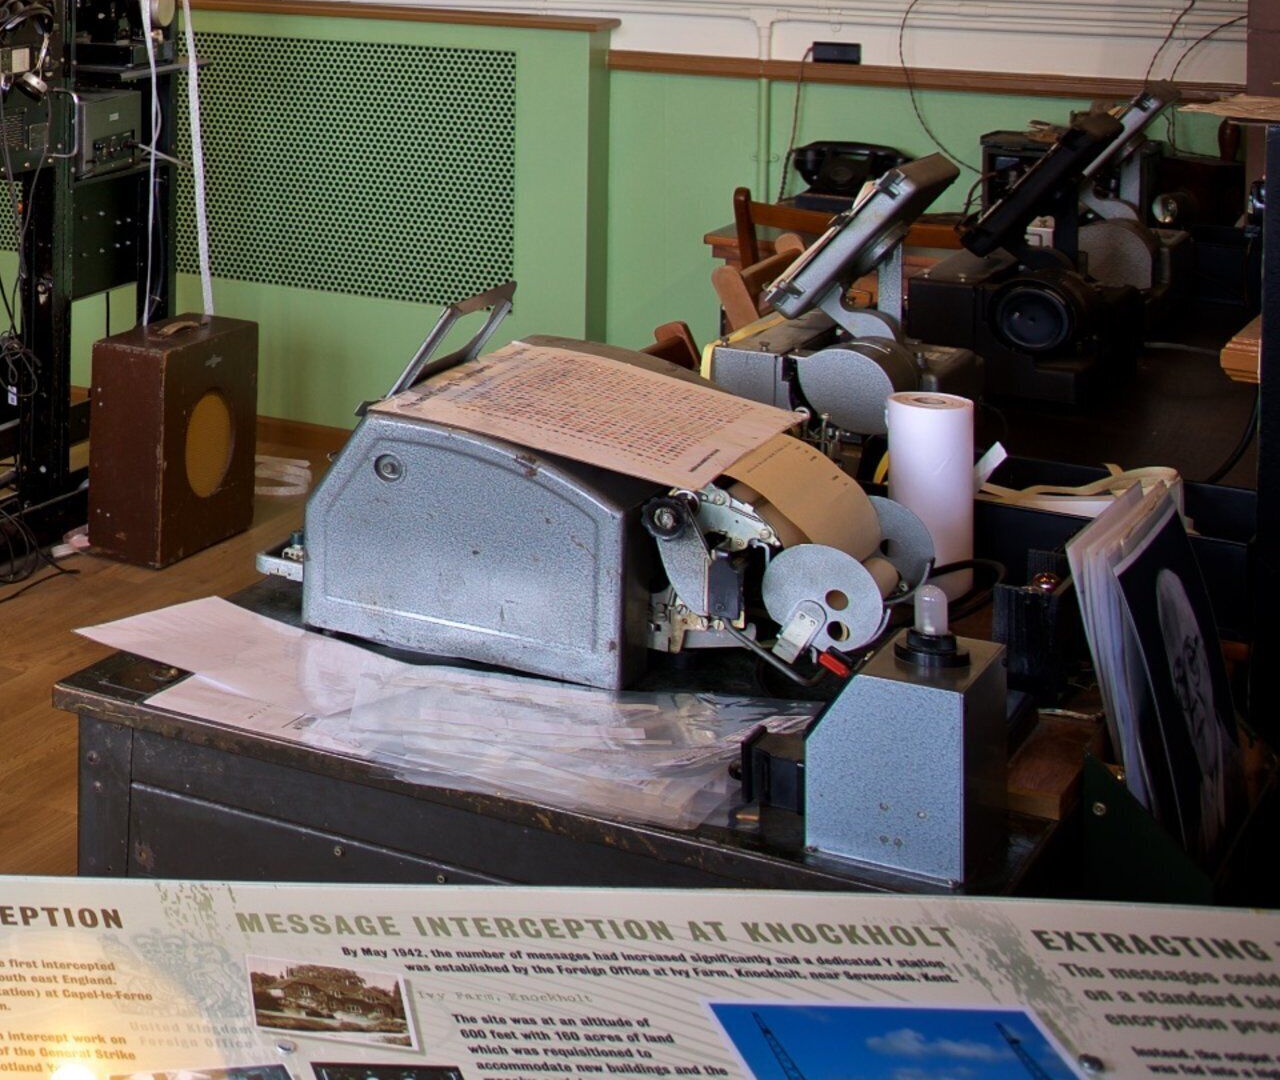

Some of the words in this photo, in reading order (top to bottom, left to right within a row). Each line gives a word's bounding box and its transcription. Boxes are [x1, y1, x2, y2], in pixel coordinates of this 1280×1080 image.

[235, 913, 400, 936] MESSAGE
[413, 916, 674, 941] INTERCEPTION
[687, 920, 728, 942] AT
[740, 921, 959, 949] KNOCKHOLT
[1031, 930, 1272, 961] EXTRACTING
[9, 959, 38, 969] first
[42, 960, 115, 971] intercepted
[1059, 962, 1105, 978] The
[1107, 968, 1219, 985] messages
[451, 1013, 476, 1024] The
[480, 1014, 505, 1024] site
[510, 1016, 537, 1025] was
[541, 1016, 555, 1025] at
[559, 1017, 574, 1027] an
[580, 1016, 633, 1028] altitude
[639, 1017, 651, 1028] of
